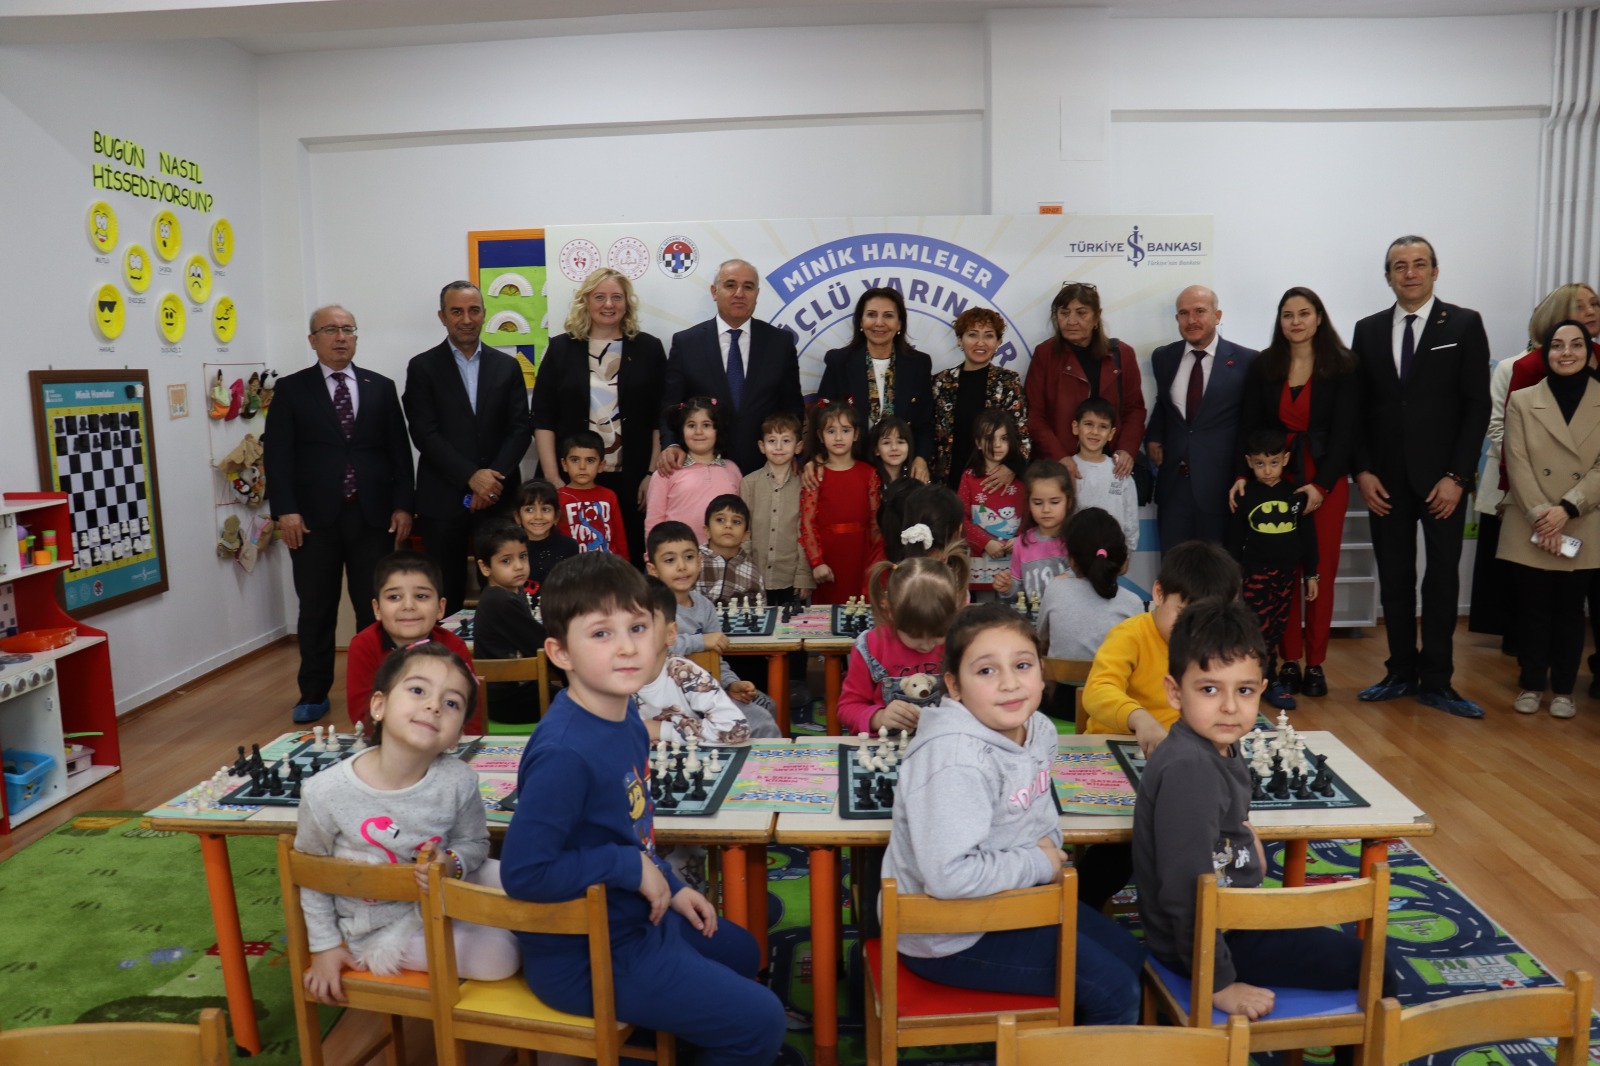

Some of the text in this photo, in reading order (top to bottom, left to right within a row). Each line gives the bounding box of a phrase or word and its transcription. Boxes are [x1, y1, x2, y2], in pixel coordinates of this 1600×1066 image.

[93, 130, 203, 184] BUGÜN NASIL
[92, 163, 214, 213] HİSSEDİYORSUN?
[782, 242, 993, 293] MİNİK HAMLELER
[1069, 240, 1125, 253] TÜRKİYE
[1147, 242, 1202, 252] BANKASI
